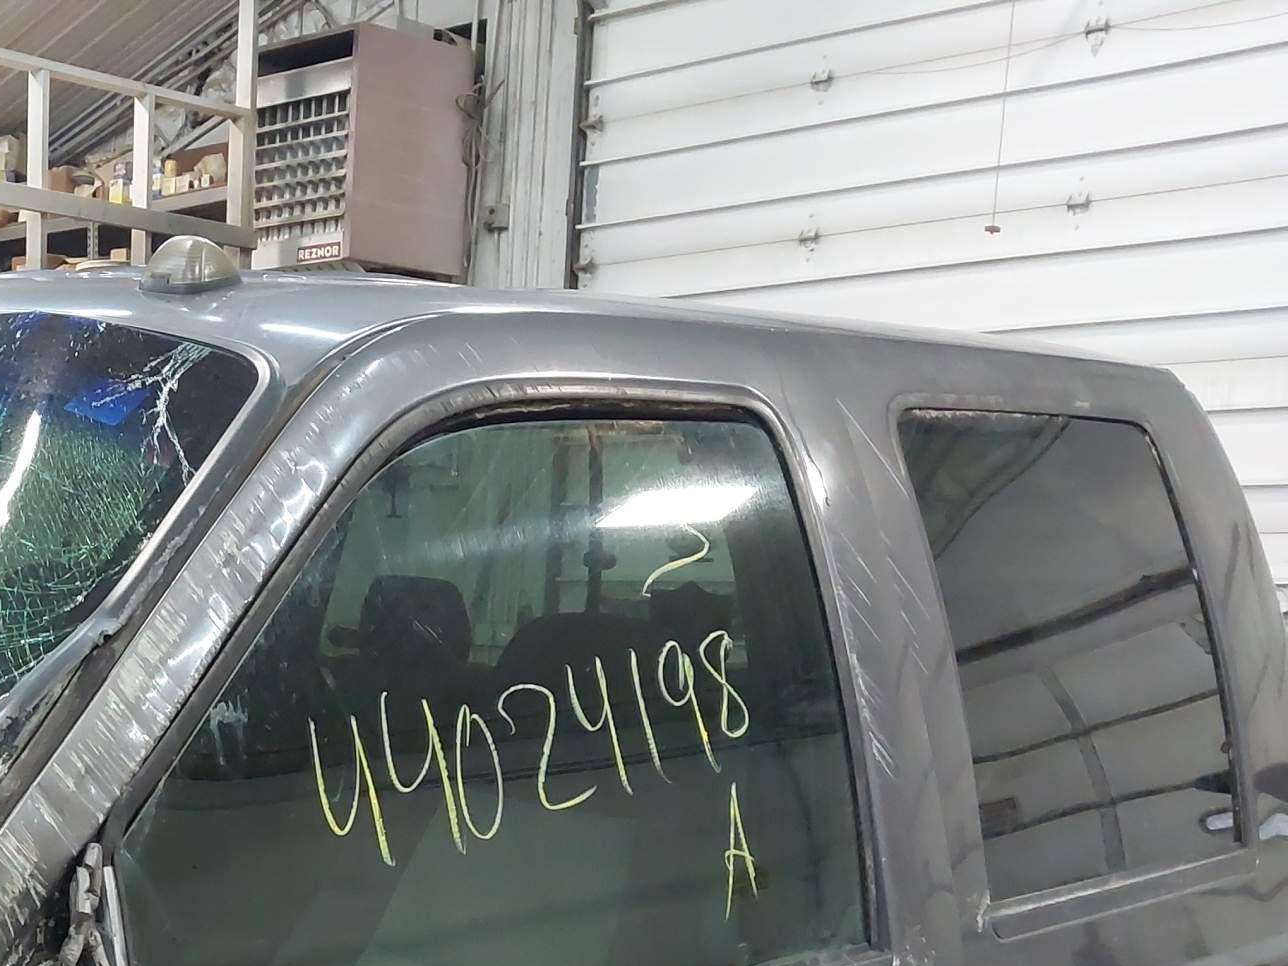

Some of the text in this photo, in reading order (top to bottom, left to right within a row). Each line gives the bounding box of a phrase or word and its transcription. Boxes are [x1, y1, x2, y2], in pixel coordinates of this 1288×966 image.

[298, 245, 340, 260] REZNOR
[308, 630, 750, 867] 44024198
[724, 781, 759, 921] A
